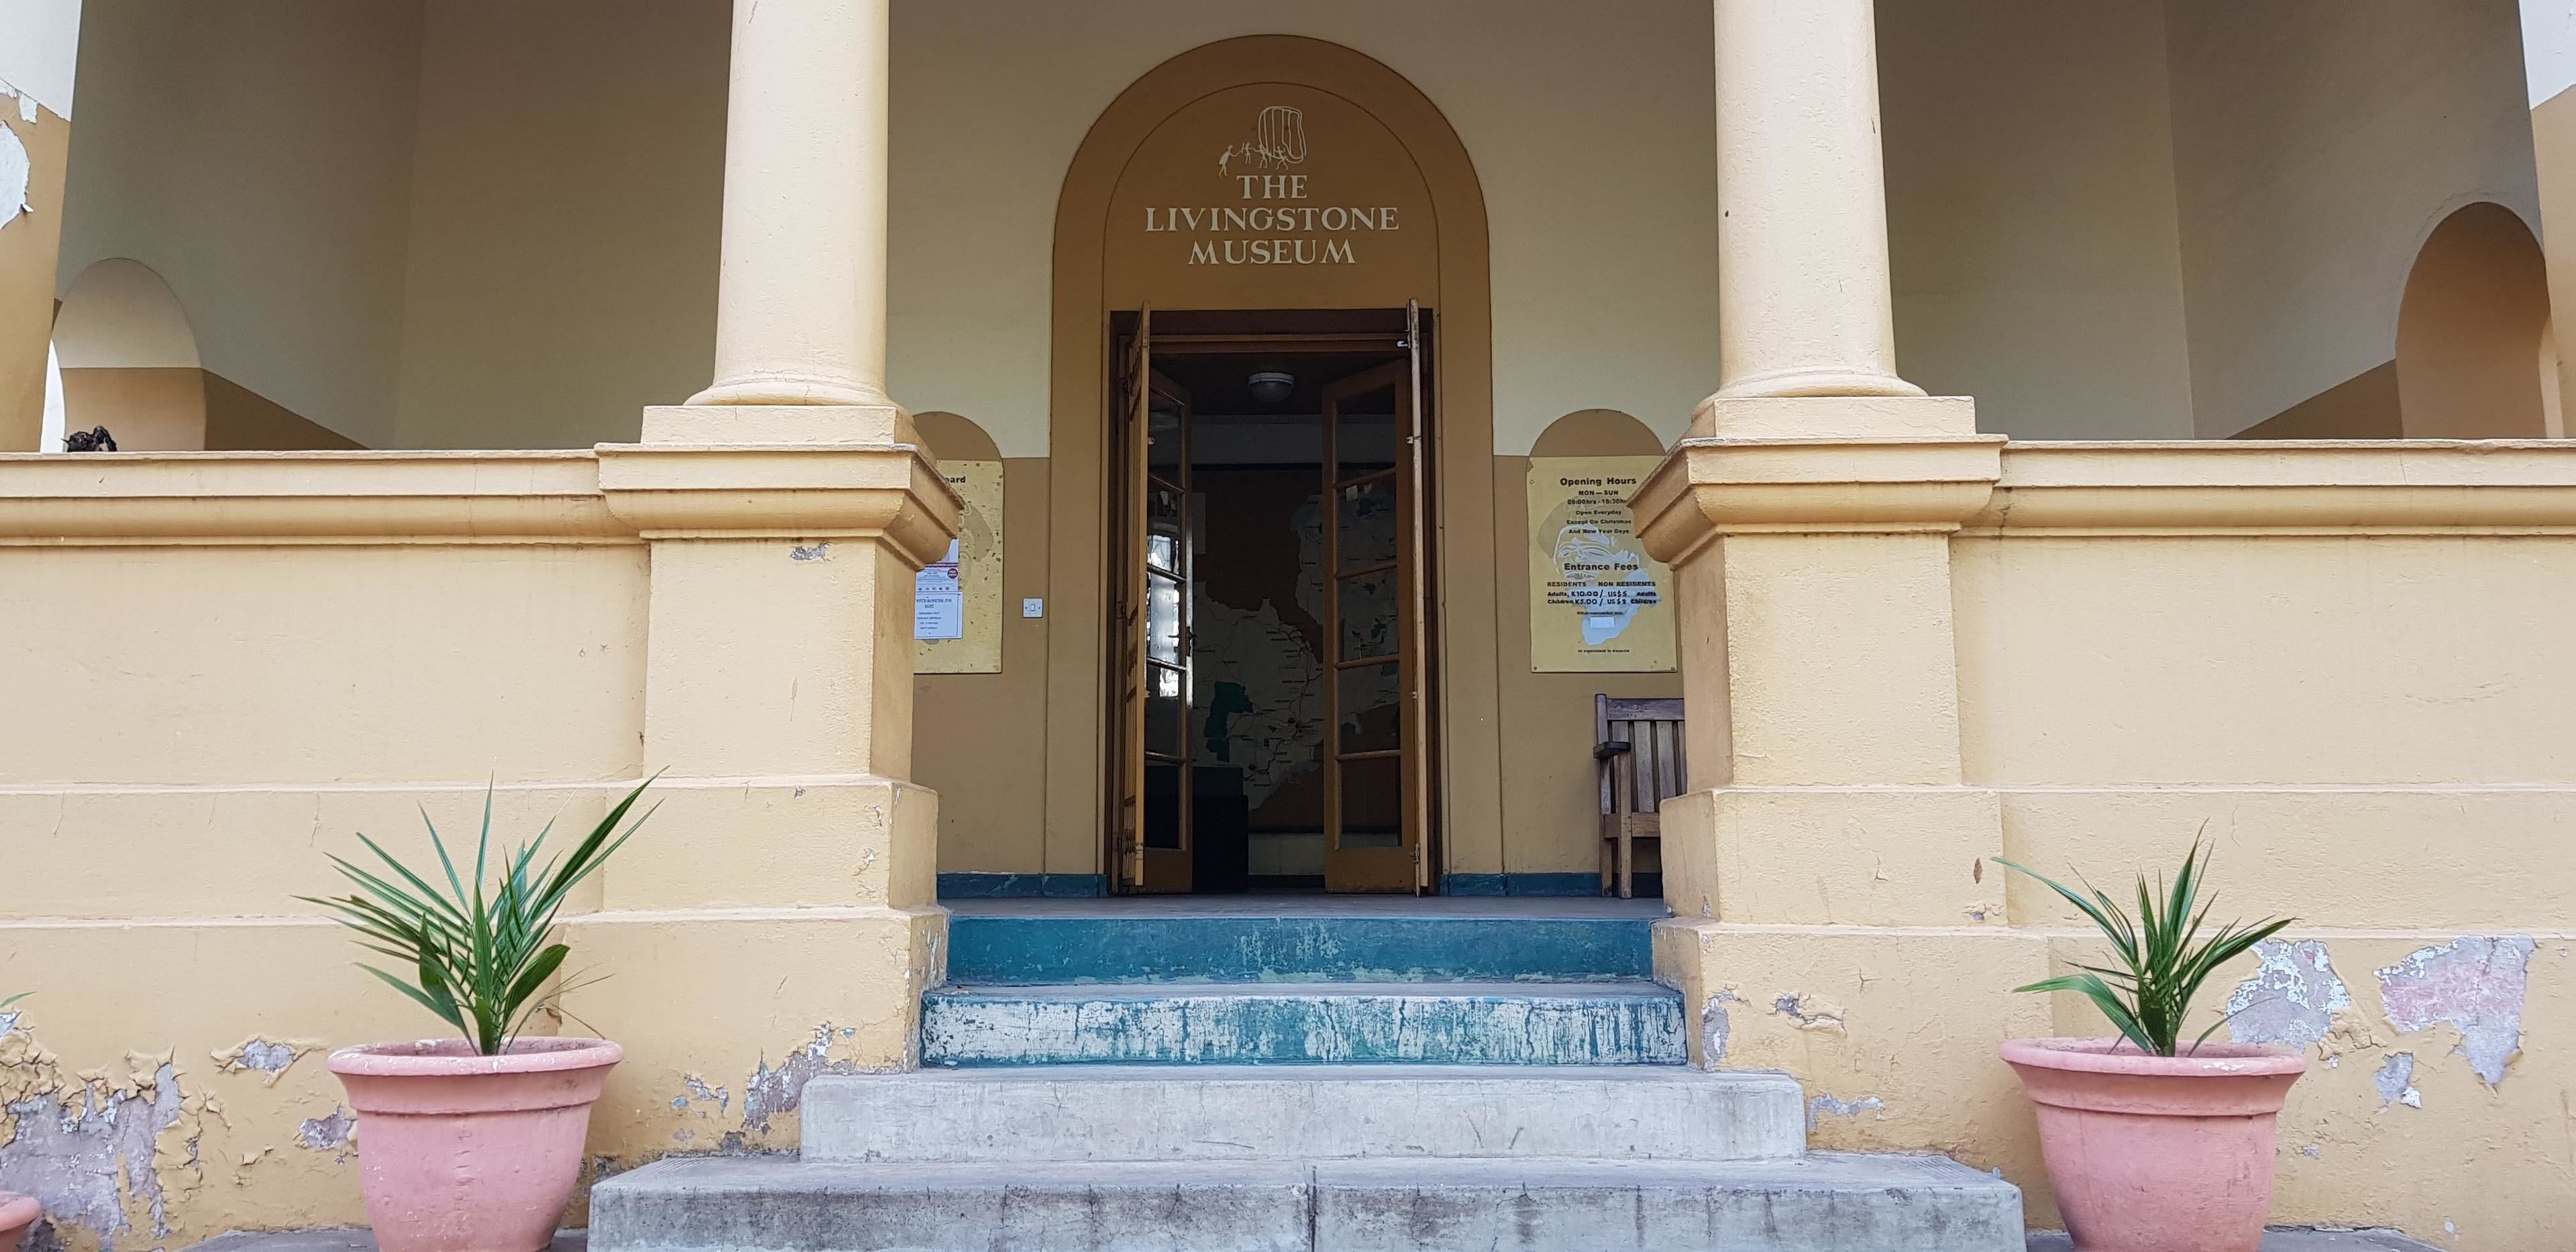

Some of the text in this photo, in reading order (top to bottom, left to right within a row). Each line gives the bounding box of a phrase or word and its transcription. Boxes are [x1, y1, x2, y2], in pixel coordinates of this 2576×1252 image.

[1236, 174, 1309, 199] THE
[1144, 206, 1399, 232] LIVINGSTONE
[1187, 238, 1356, 265] MUSEUM
[1560, 477, 1602, 486] Opening
